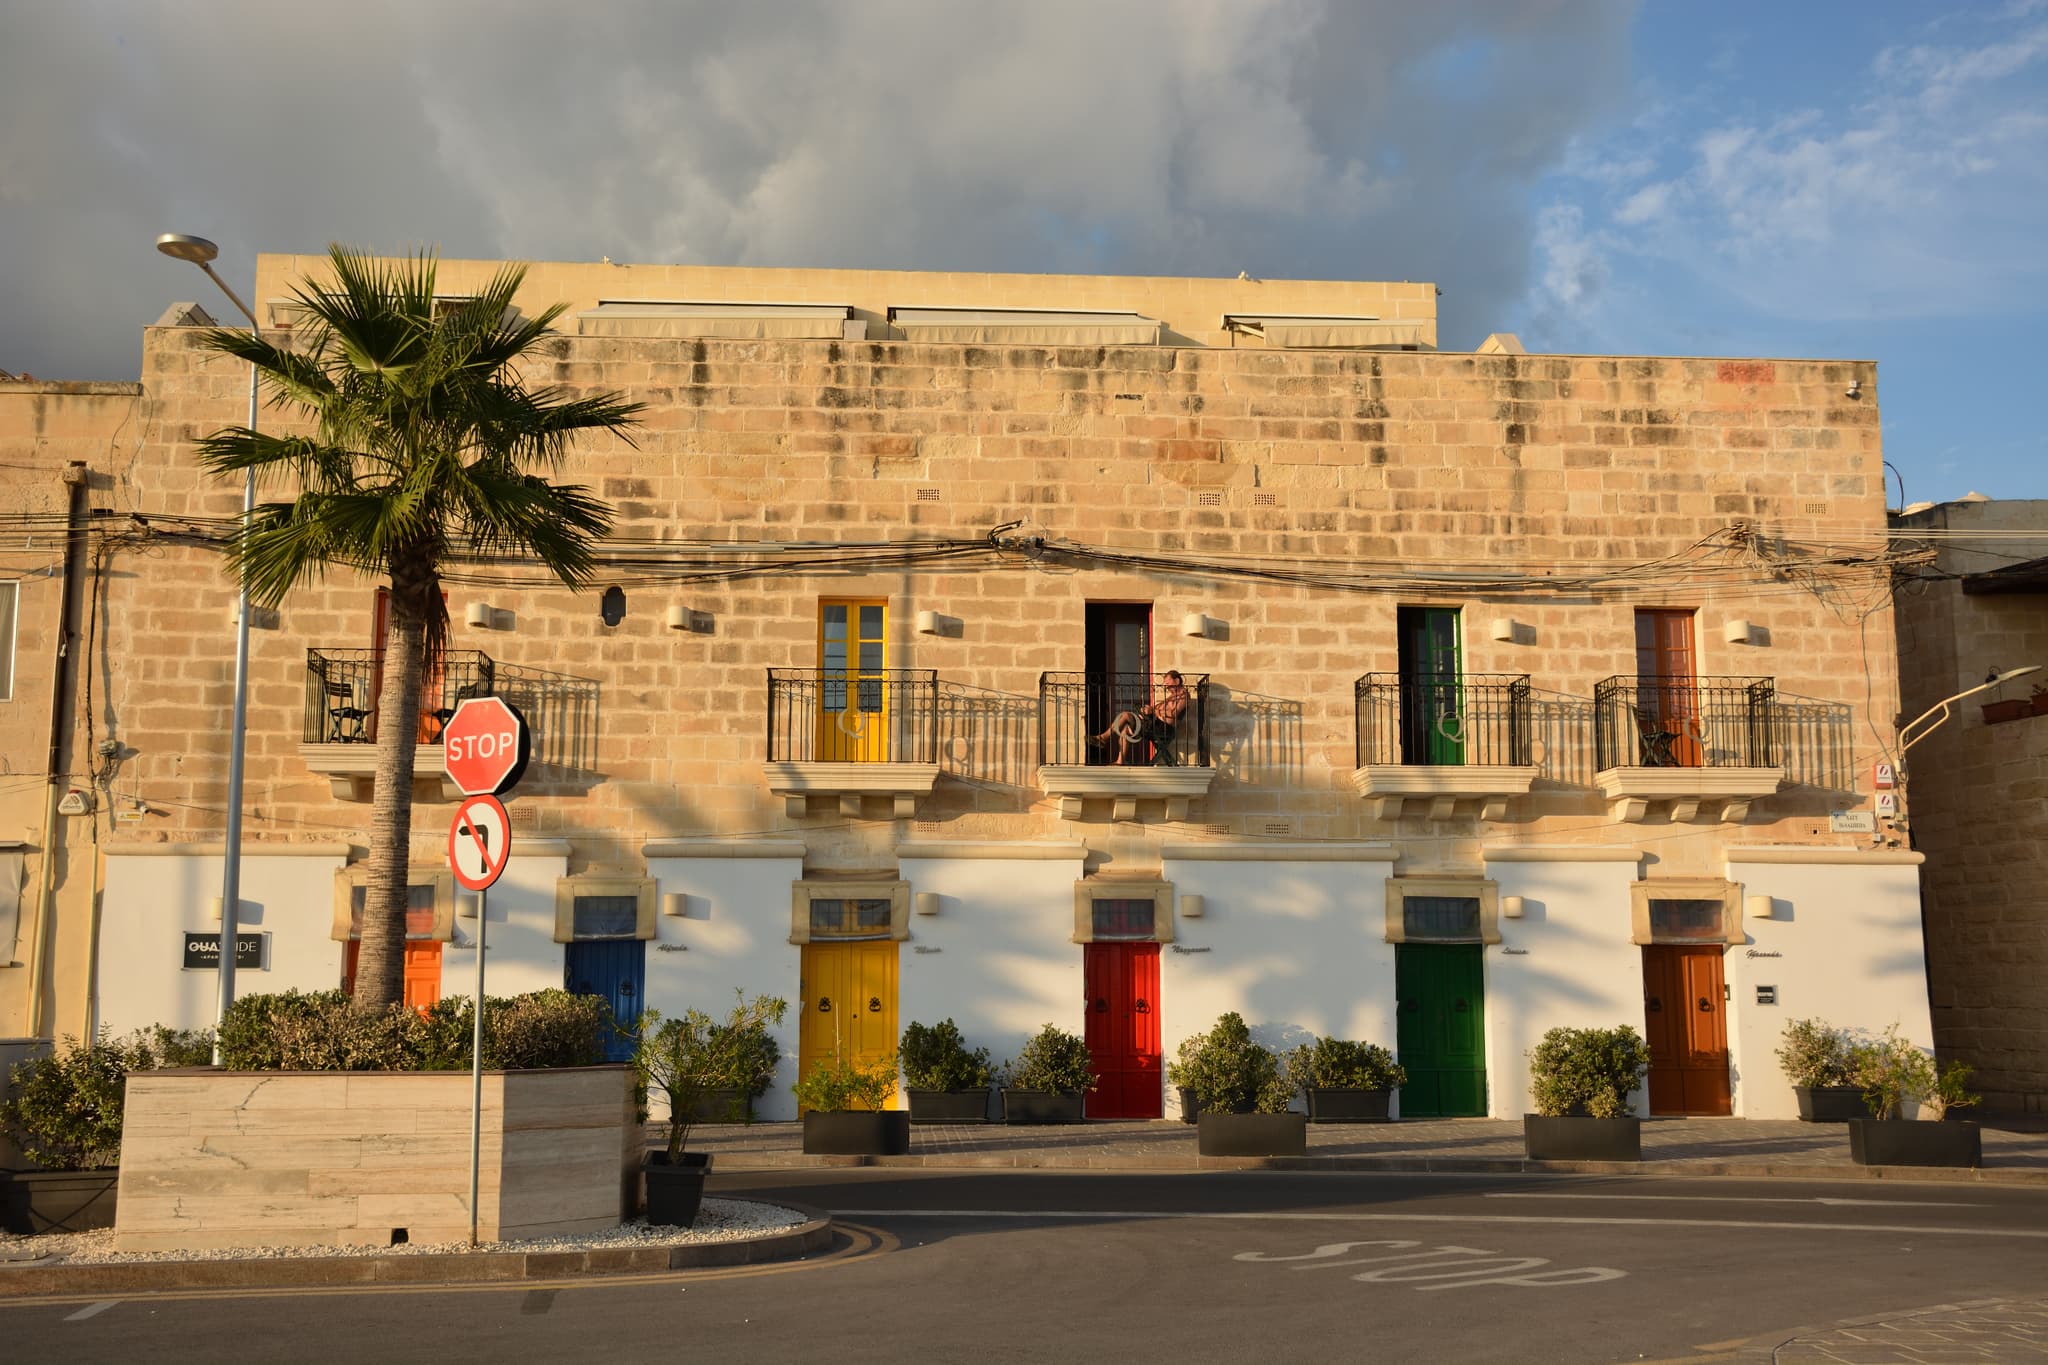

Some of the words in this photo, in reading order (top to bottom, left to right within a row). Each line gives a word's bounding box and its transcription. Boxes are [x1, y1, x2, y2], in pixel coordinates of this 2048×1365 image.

[449, 732, 513, 762] STOP
[188, 941, 257, 952] QUAIDE
[1232, 1240, 1631, 1291] STOP
